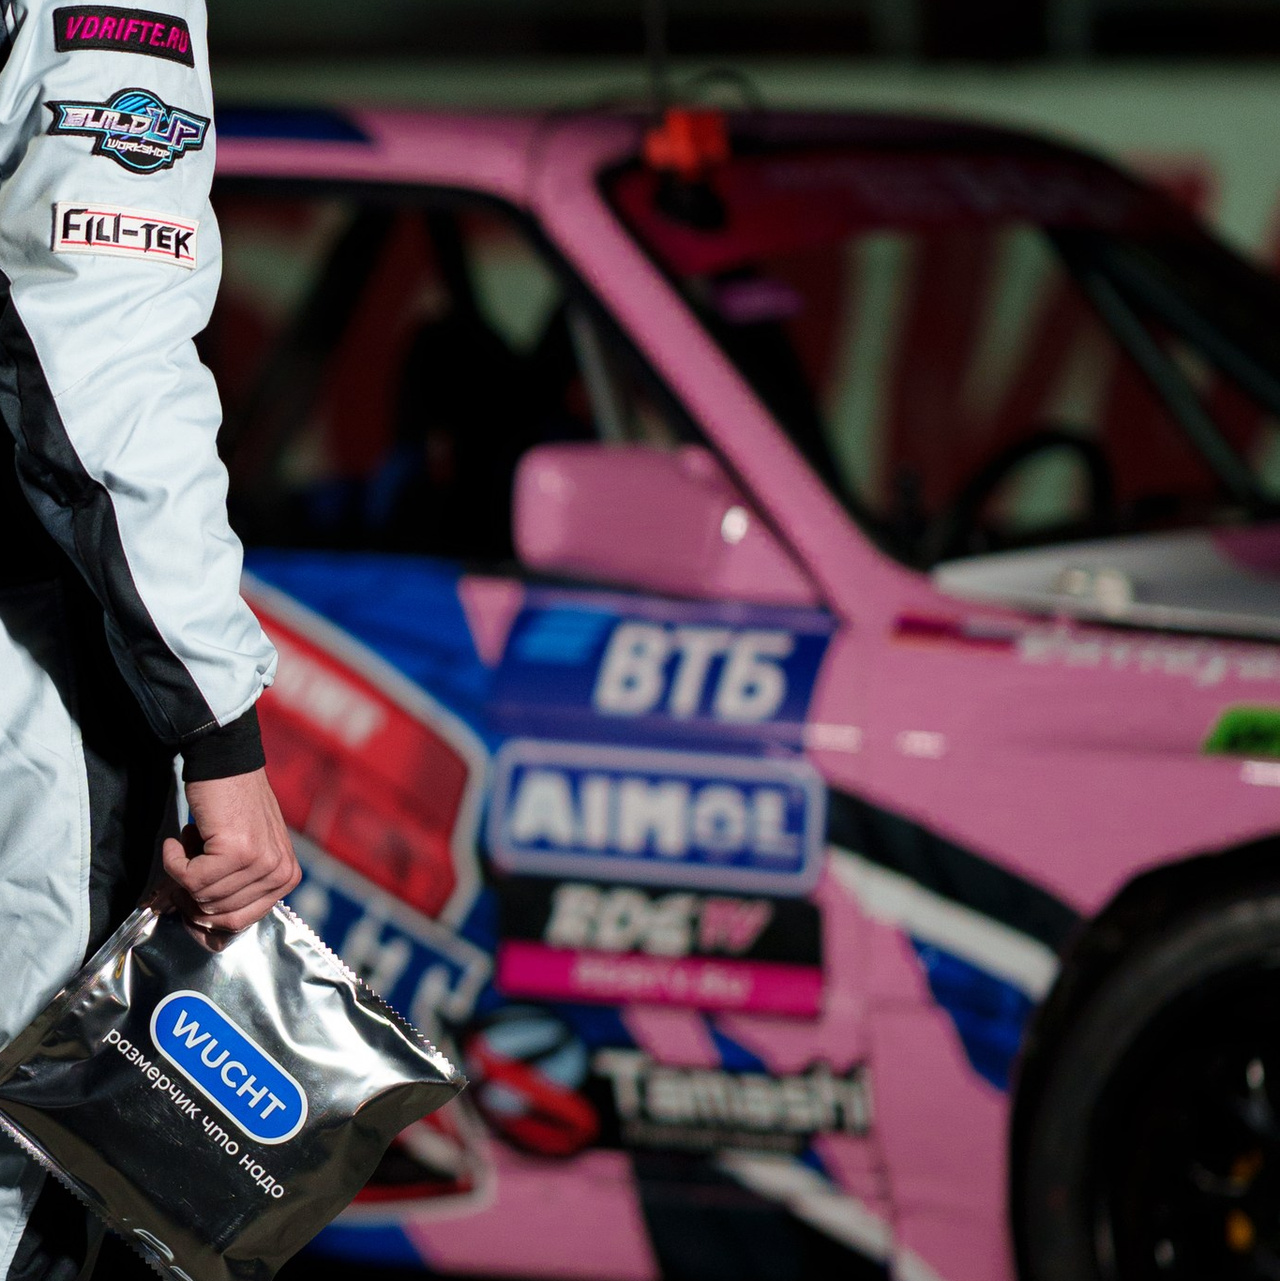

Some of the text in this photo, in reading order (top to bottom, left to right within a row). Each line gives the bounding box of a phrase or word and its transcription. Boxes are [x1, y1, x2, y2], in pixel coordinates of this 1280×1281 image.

[65, 16, 189, 53] VDRIFTE.RU
[107, 138, 170, 158] WORKSHOP
[170, 1009, 286, 1121] WUCHT
[102, 1028, 202, 1121] размерчик
[239, 1155, 285, 1200] надо
